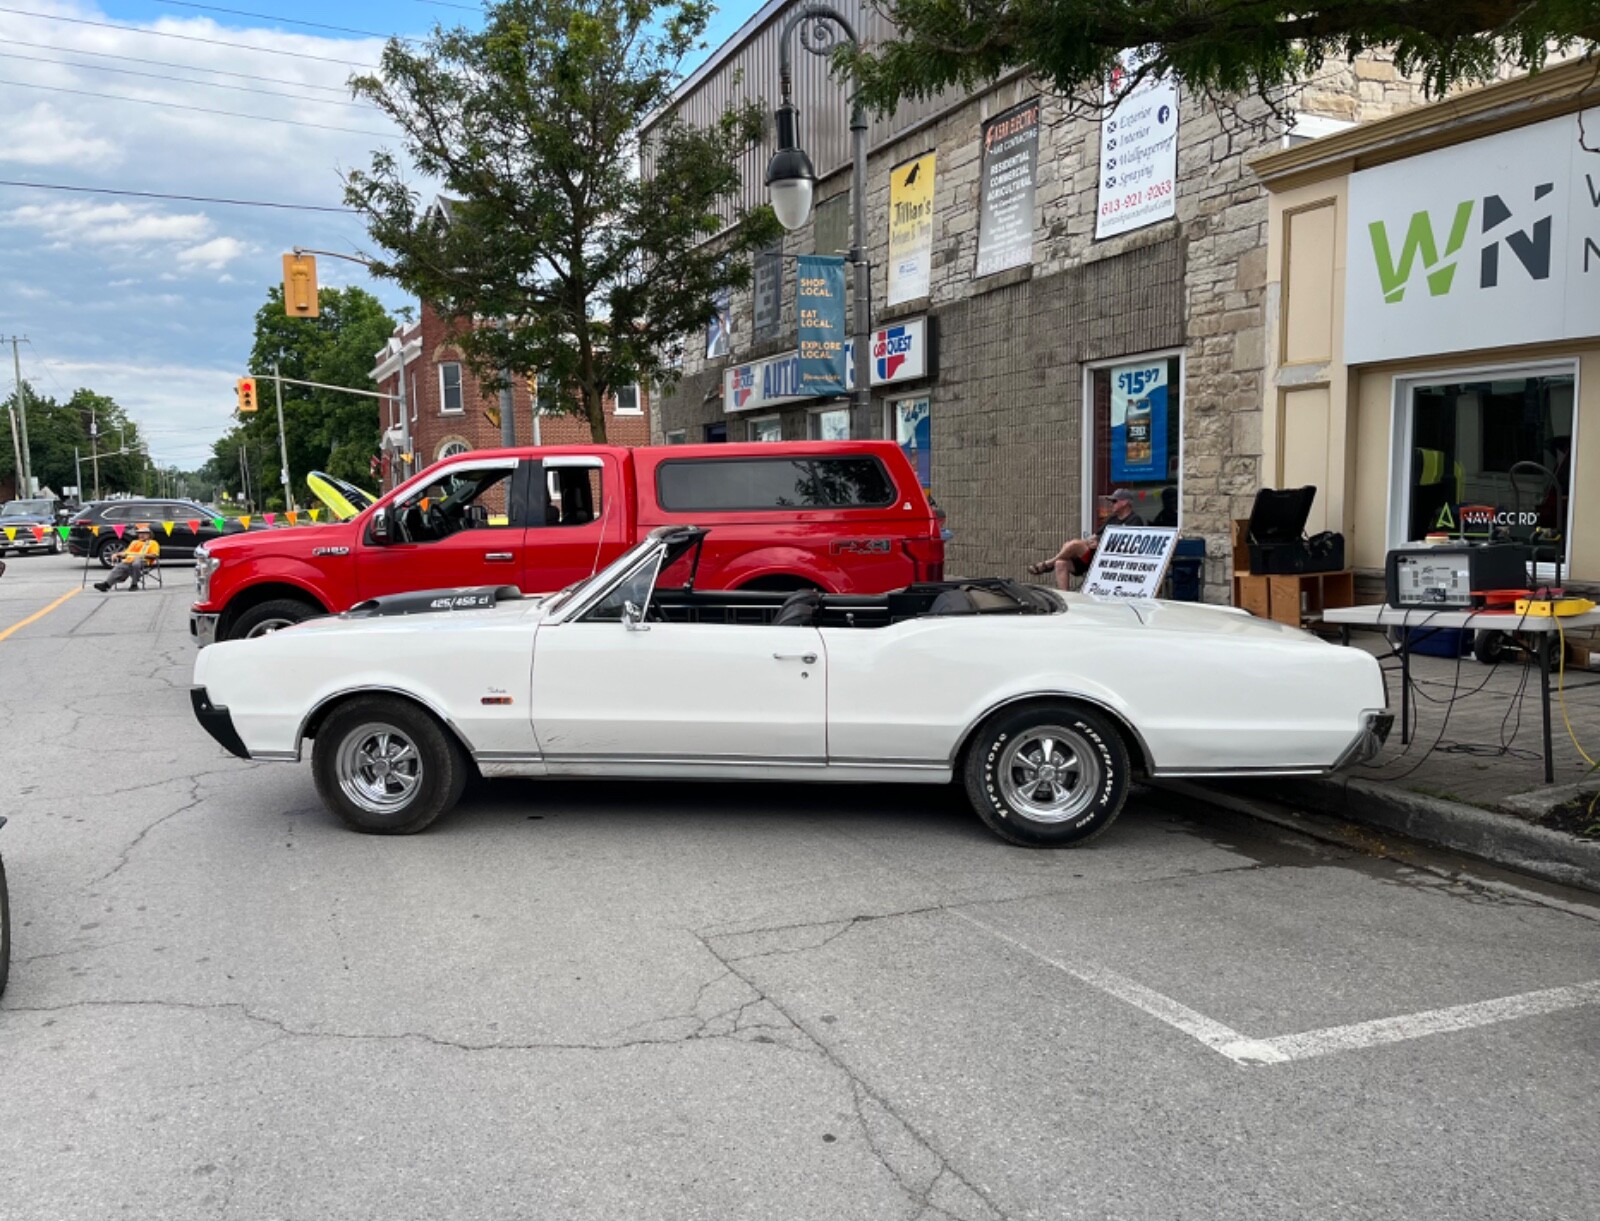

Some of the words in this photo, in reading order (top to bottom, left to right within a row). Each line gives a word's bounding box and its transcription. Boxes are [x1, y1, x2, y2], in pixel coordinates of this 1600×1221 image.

[1119, 107, 1152, 129] Exterior
[1119, 127, 1150, 147] Interior
[990, 150, 1029, 175] RESIDENTIAL
[990, 163, 1029, 188] COMMERCIAL
[1118, 165, 1153, 187] Spraying
[987, 175, 1032, 201] AGRICULTURAL
[800, 278, 826, 287] SHOP
[800, 287, 833, 297] LOCAL.
[800, 310, 817, 318] EAT
[800, 319, 833, 328] LOCAL.
[801, 341, 841, 350] EXPLORE
[801, 350, 833, 359] LOCAL.
[1104, 533, 1171, 556] WELCOME
[1098, 559, 1109, 568] WE
[1109, 560, 1125, 570] HOPE
[1125, 561, 1139, 570] YOU
[1138, 562, 1158, 571] ENJOY
[1100, 571, 1117, 580] YOUR
[1089, 582, 1111, 596] Please
[430, 596, 477, 608] 425/455
[1074, 721, 1113, 806] FIREHAWK
